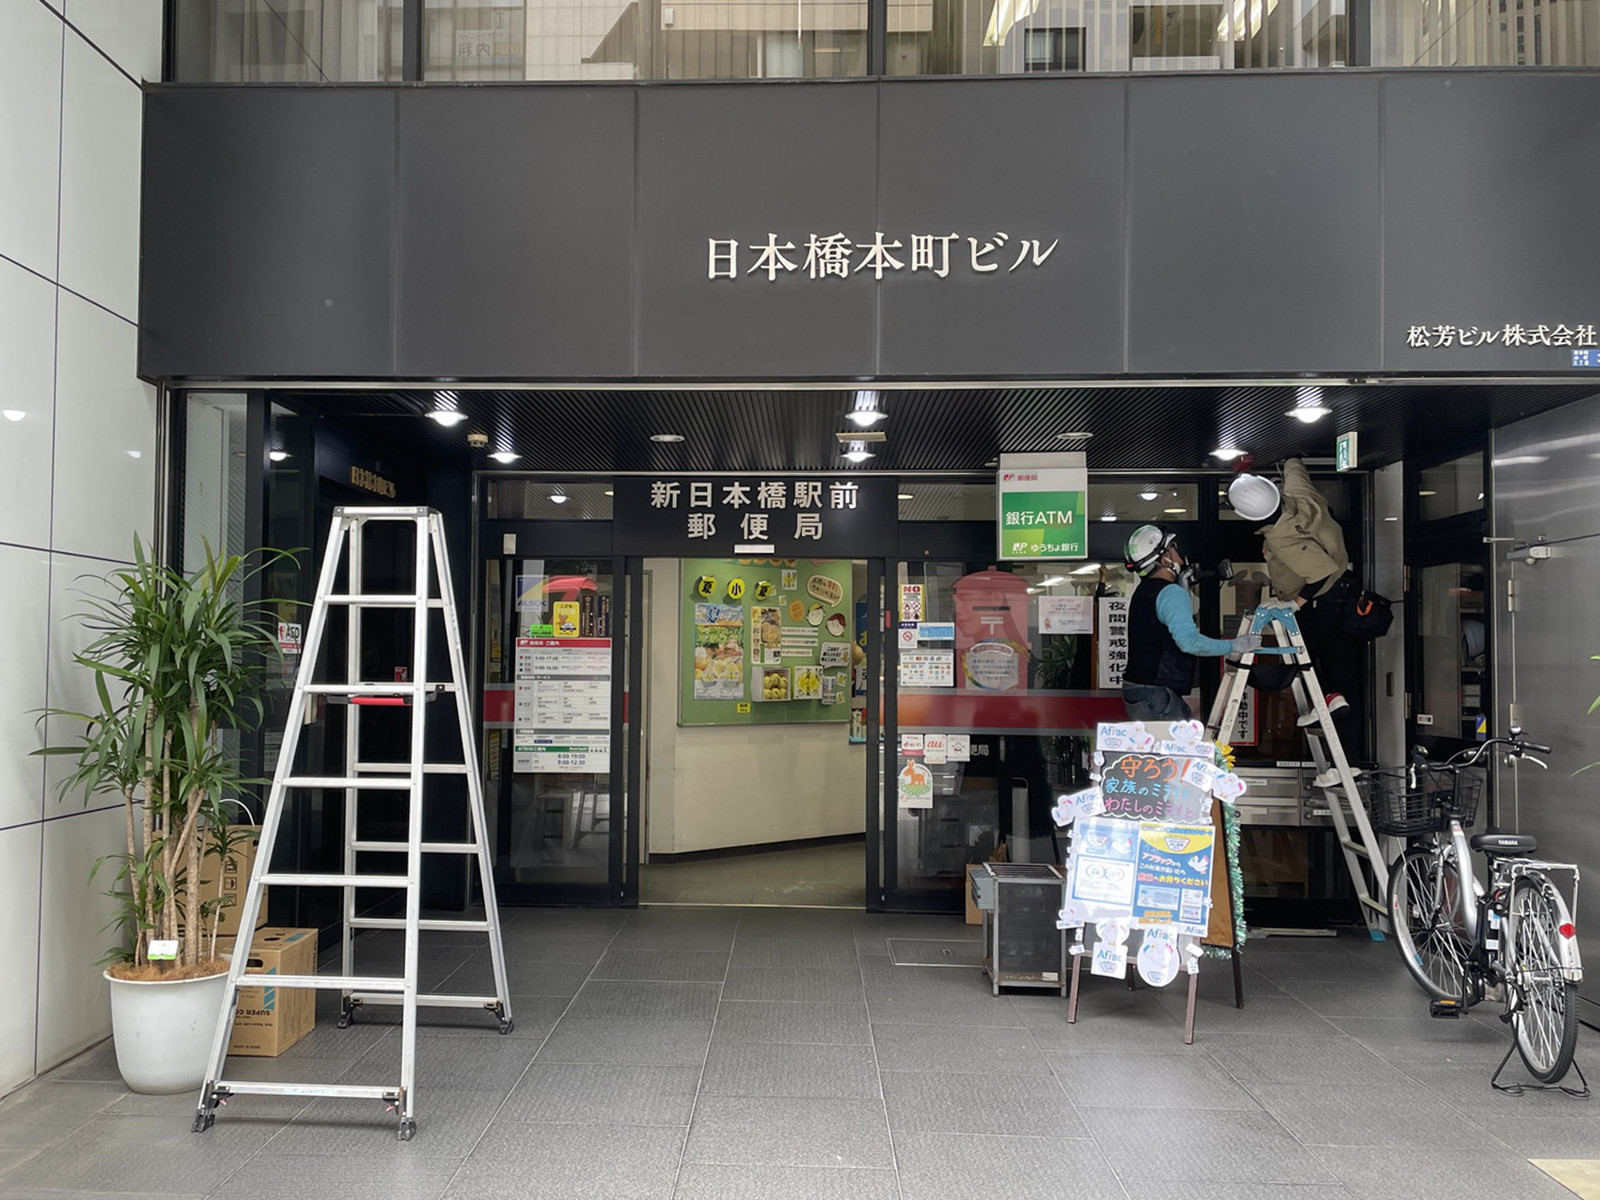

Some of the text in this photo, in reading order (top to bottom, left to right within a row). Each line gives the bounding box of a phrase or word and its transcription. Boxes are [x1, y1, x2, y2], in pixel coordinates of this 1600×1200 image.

[708, 232, 1059, 281] 日本橋本町ビル
[1406, 324, 1598, 347] 松芳ビル株式会社
[651, 481, 859, 509] 新日本橋駅前
[1005, 510, 1073, 525] 銀行ATM
[688, 512, 823, 540] 郵便局
[1031, 542, 1079, 553] ゆうちょ銀行
[903, 585, 921, 593] NO
[1108, 601, 1127, 685] 夜間警戒強化中
[1100, 726, 1127, 737] Aflac
[1147, 928, 1174, 940] Aflac
[1097, 950, 1123, 962] Aflac
